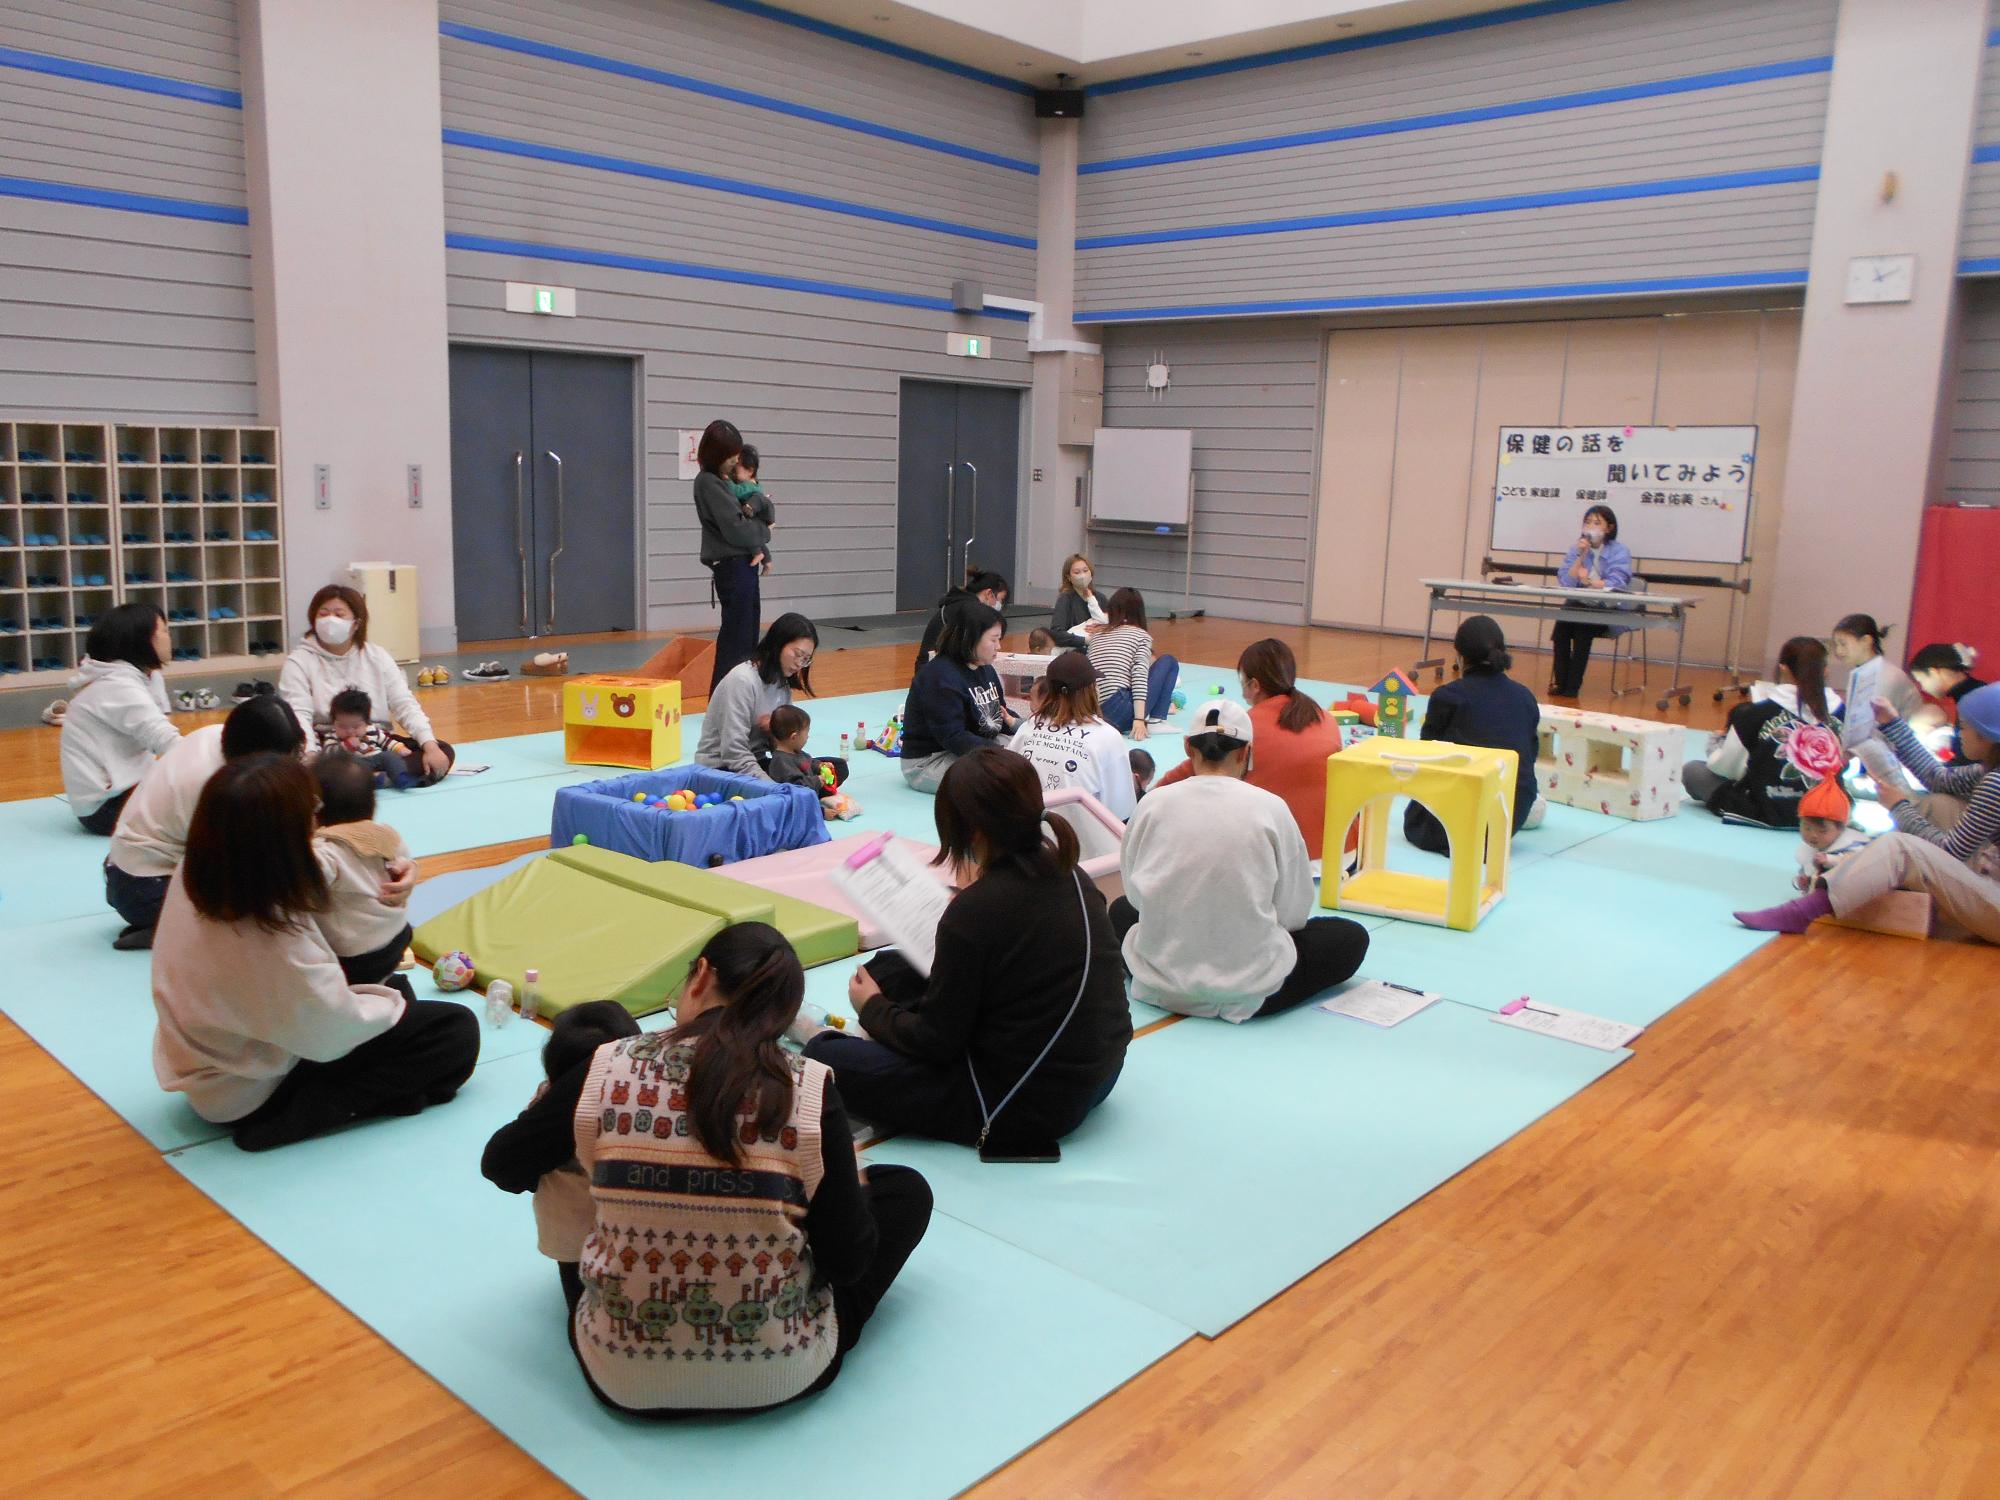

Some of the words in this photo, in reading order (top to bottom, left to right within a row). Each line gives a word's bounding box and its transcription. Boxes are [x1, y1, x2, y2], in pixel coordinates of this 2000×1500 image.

[1506, 433, 1624, 455] 保健の話を
[1607, 463, 1746, 484] 聞いてみよう
[1033, 721, 1091, 740] ROXY
[626, 1163, 671, 1187] and
